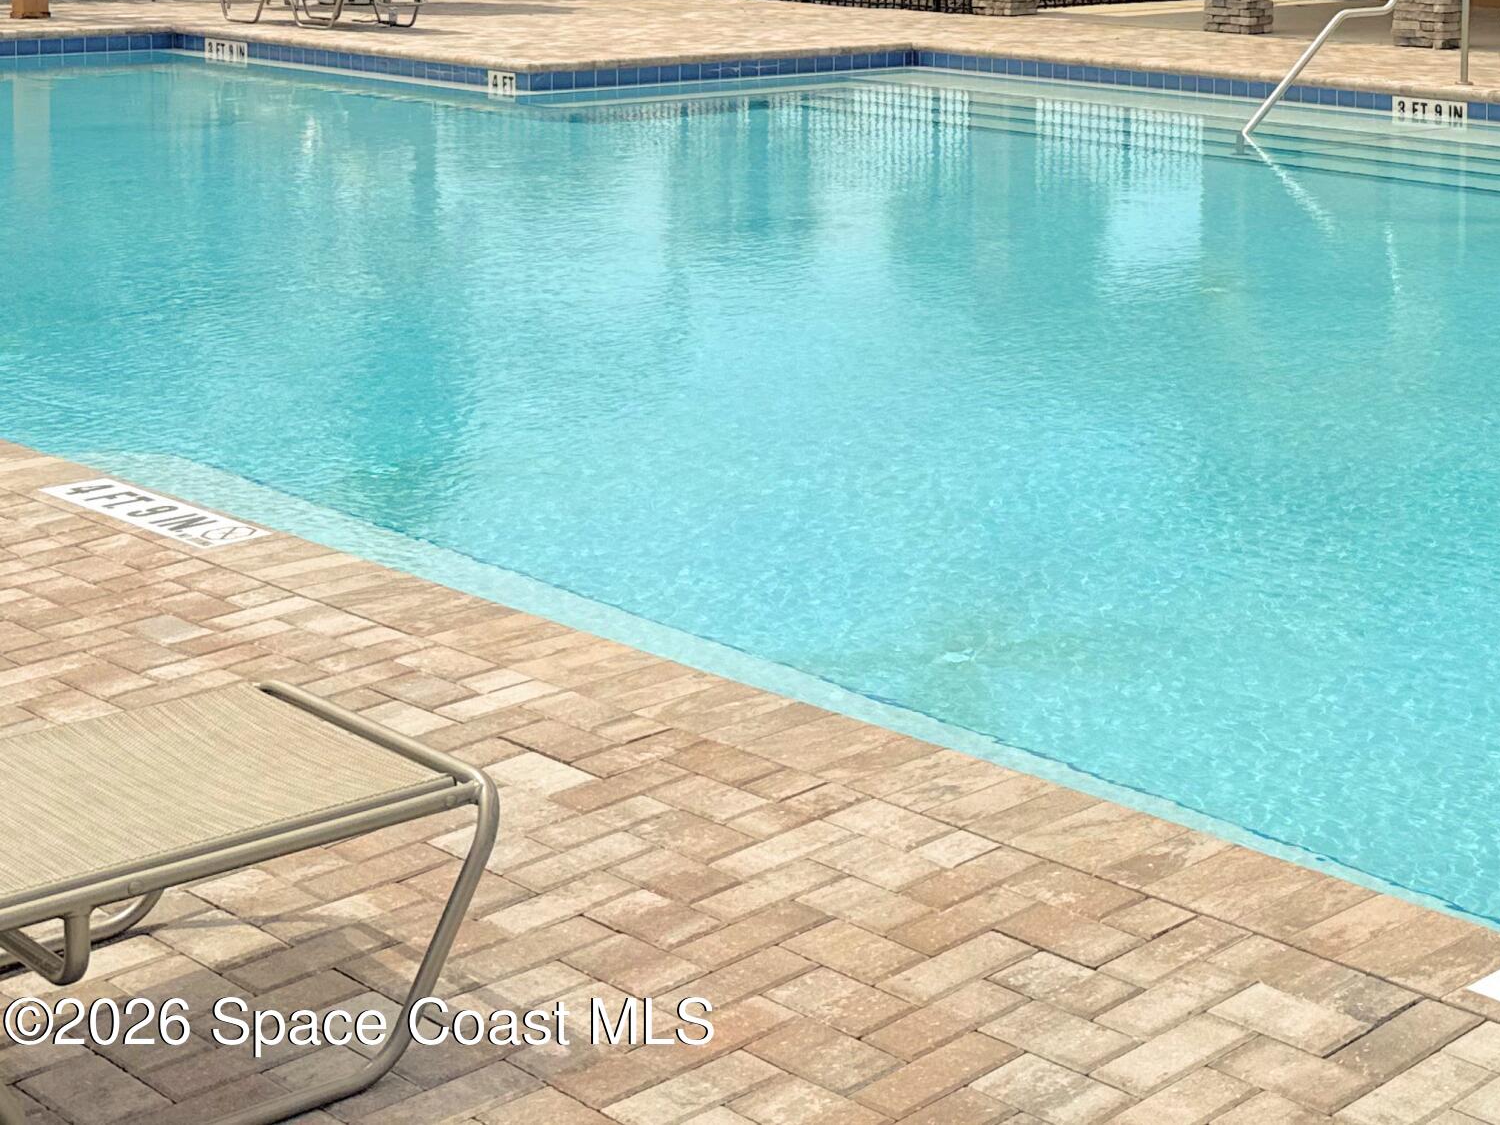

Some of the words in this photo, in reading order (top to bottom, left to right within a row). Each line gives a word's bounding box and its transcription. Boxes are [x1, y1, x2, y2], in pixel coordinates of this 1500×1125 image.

[502, 75, 514, 91] FT
[1398, 100, 1406, 114] 3
[1412, 101, 1428, 115] FT
[1434, 103, 1443, 117] 9
[1448, 104, 1463, 119] IN
[66, 484, 115, 496] 4
[127, 504, 179, 518] 9
